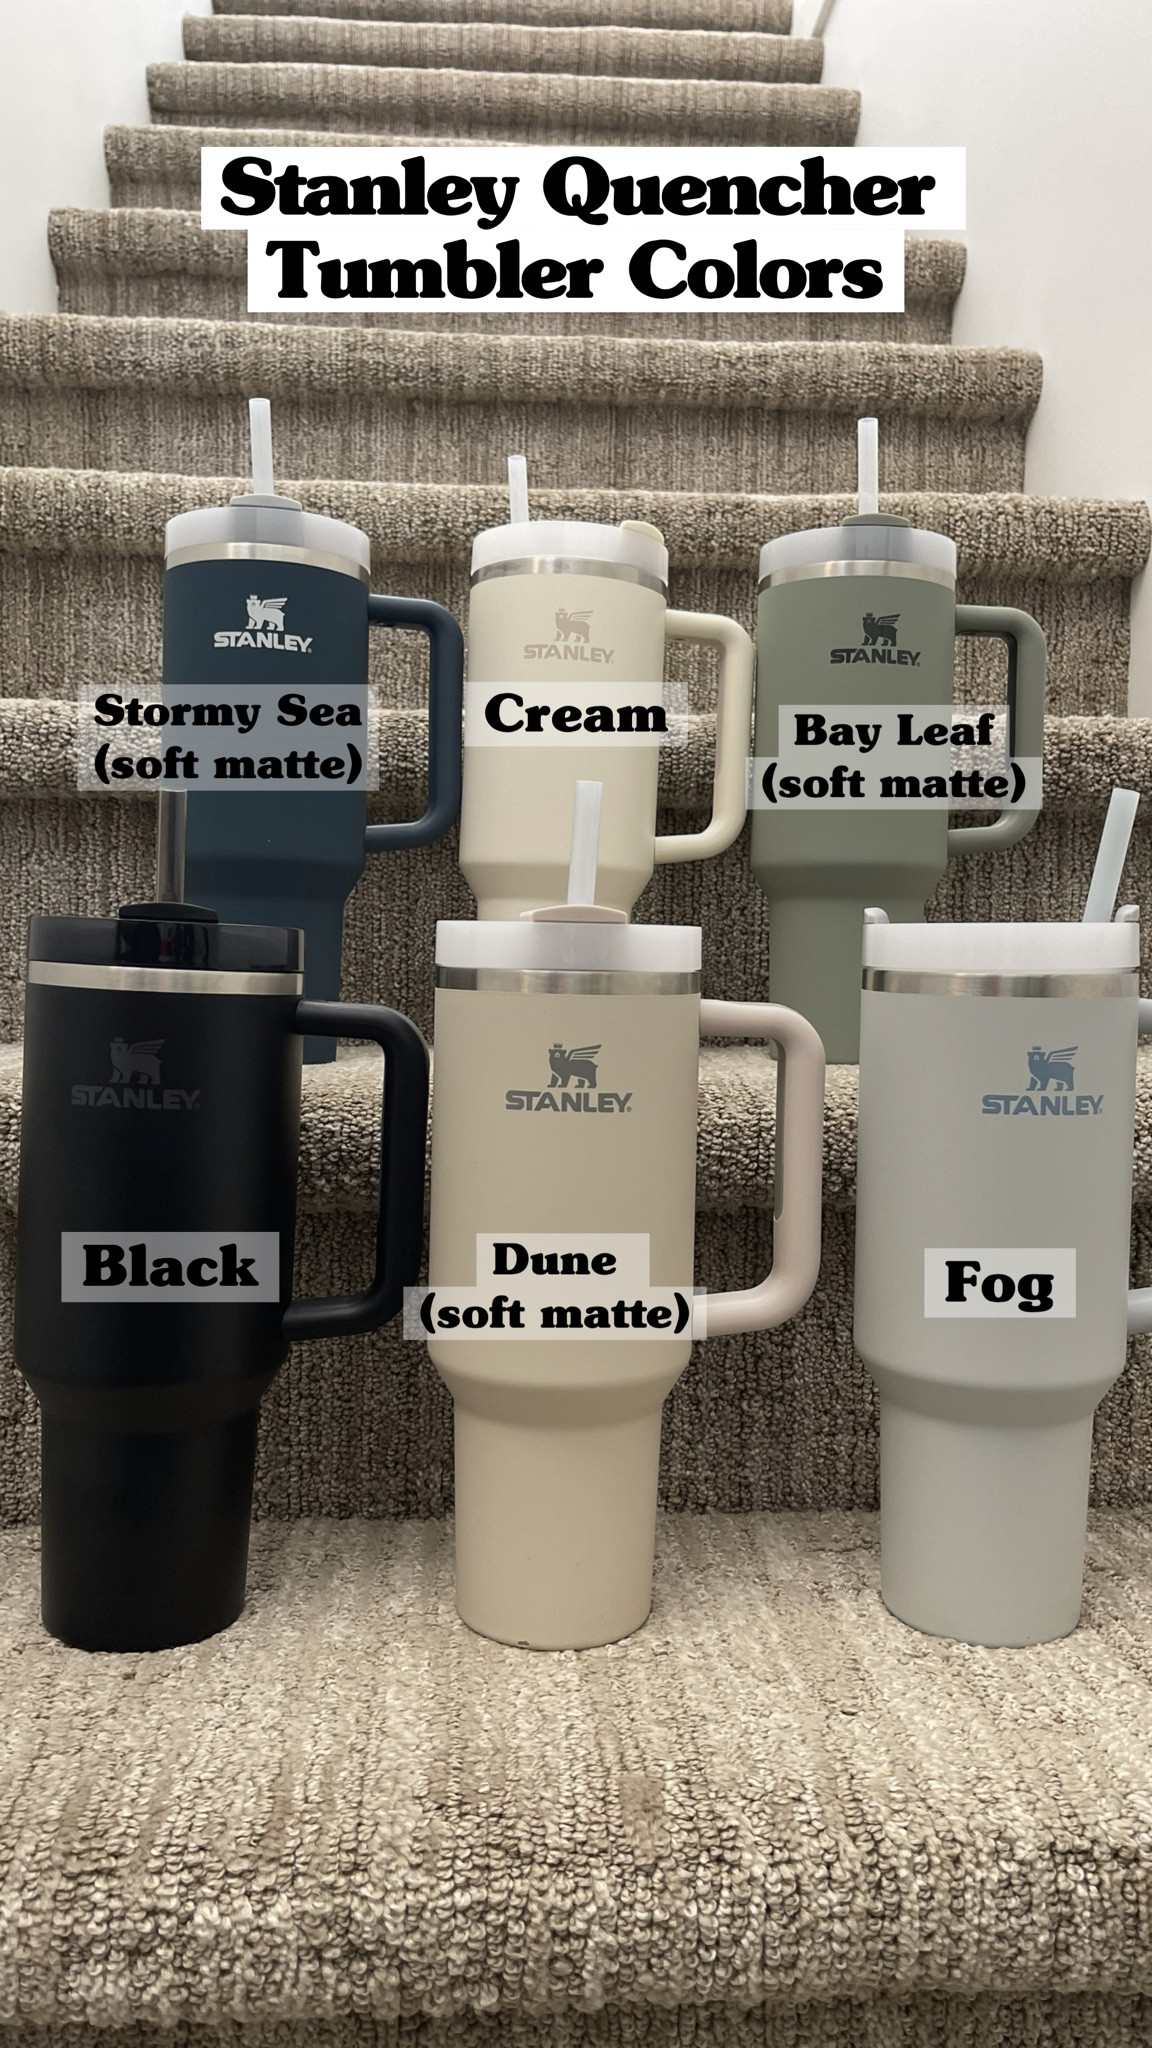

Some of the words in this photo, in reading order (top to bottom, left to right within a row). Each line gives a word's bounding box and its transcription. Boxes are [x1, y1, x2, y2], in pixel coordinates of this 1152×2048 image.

[214, 631, 313, 653] STANLEY
[523, 644, 615, 664] STANLEY
[830, 648, 921, 667] STANLEY
[71, 1084, 200, 1110] STANLEY
[506, 1090, 633, 1113] STANLEY
[982, 1094, 1104, 1116] STANLEY
